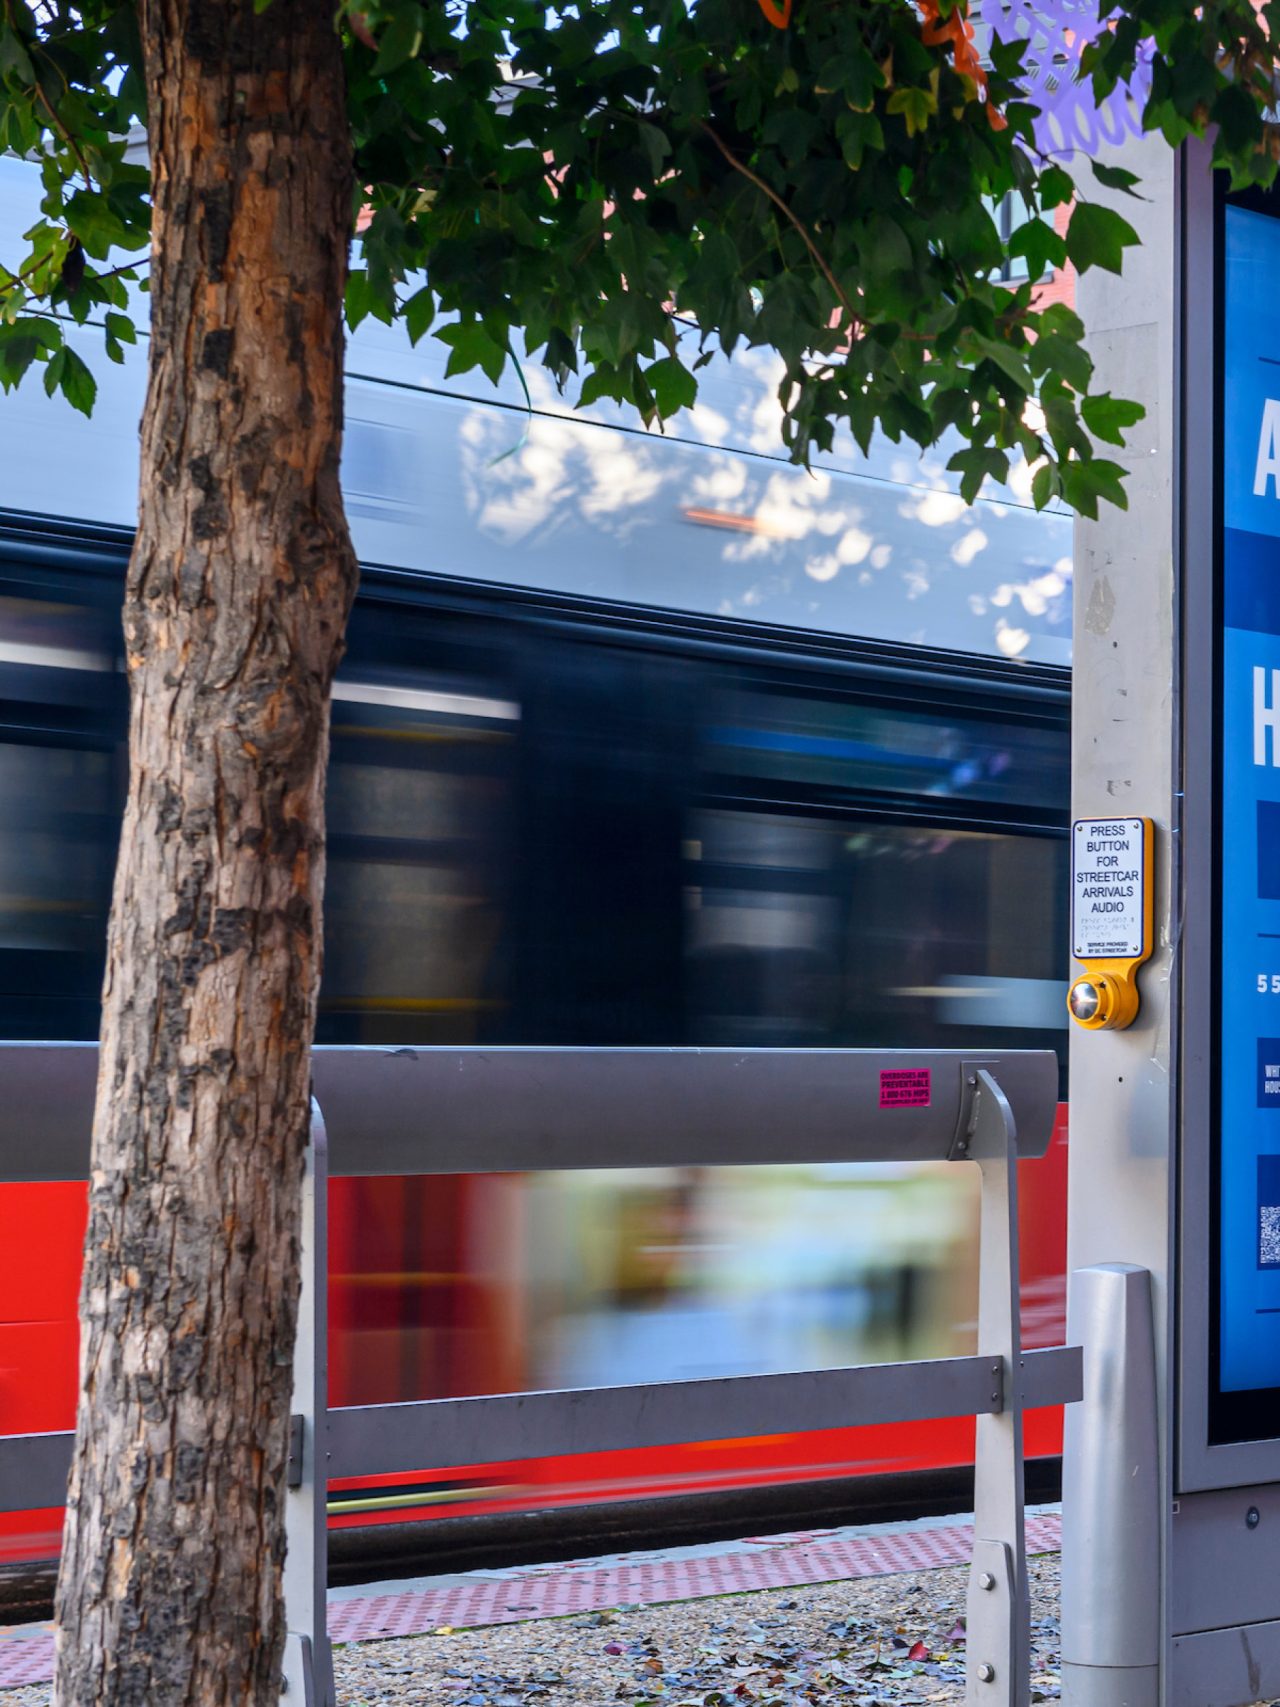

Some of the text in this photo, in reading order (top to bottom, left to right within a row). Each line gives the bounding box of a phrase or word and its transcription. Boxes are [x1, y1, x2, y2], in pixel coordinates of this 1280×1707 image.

[1090, 825, 1125, 836] PRESS
[1087, 841, 1129, 852] BUTTON
[1096, 856, 1119, 867] FOR
[1076, 871, 1139, 883] STREETCAR
[1082, 886, 1134, 898] ARRIVALS
[1091, 902, 1124, 913] AUDIO
